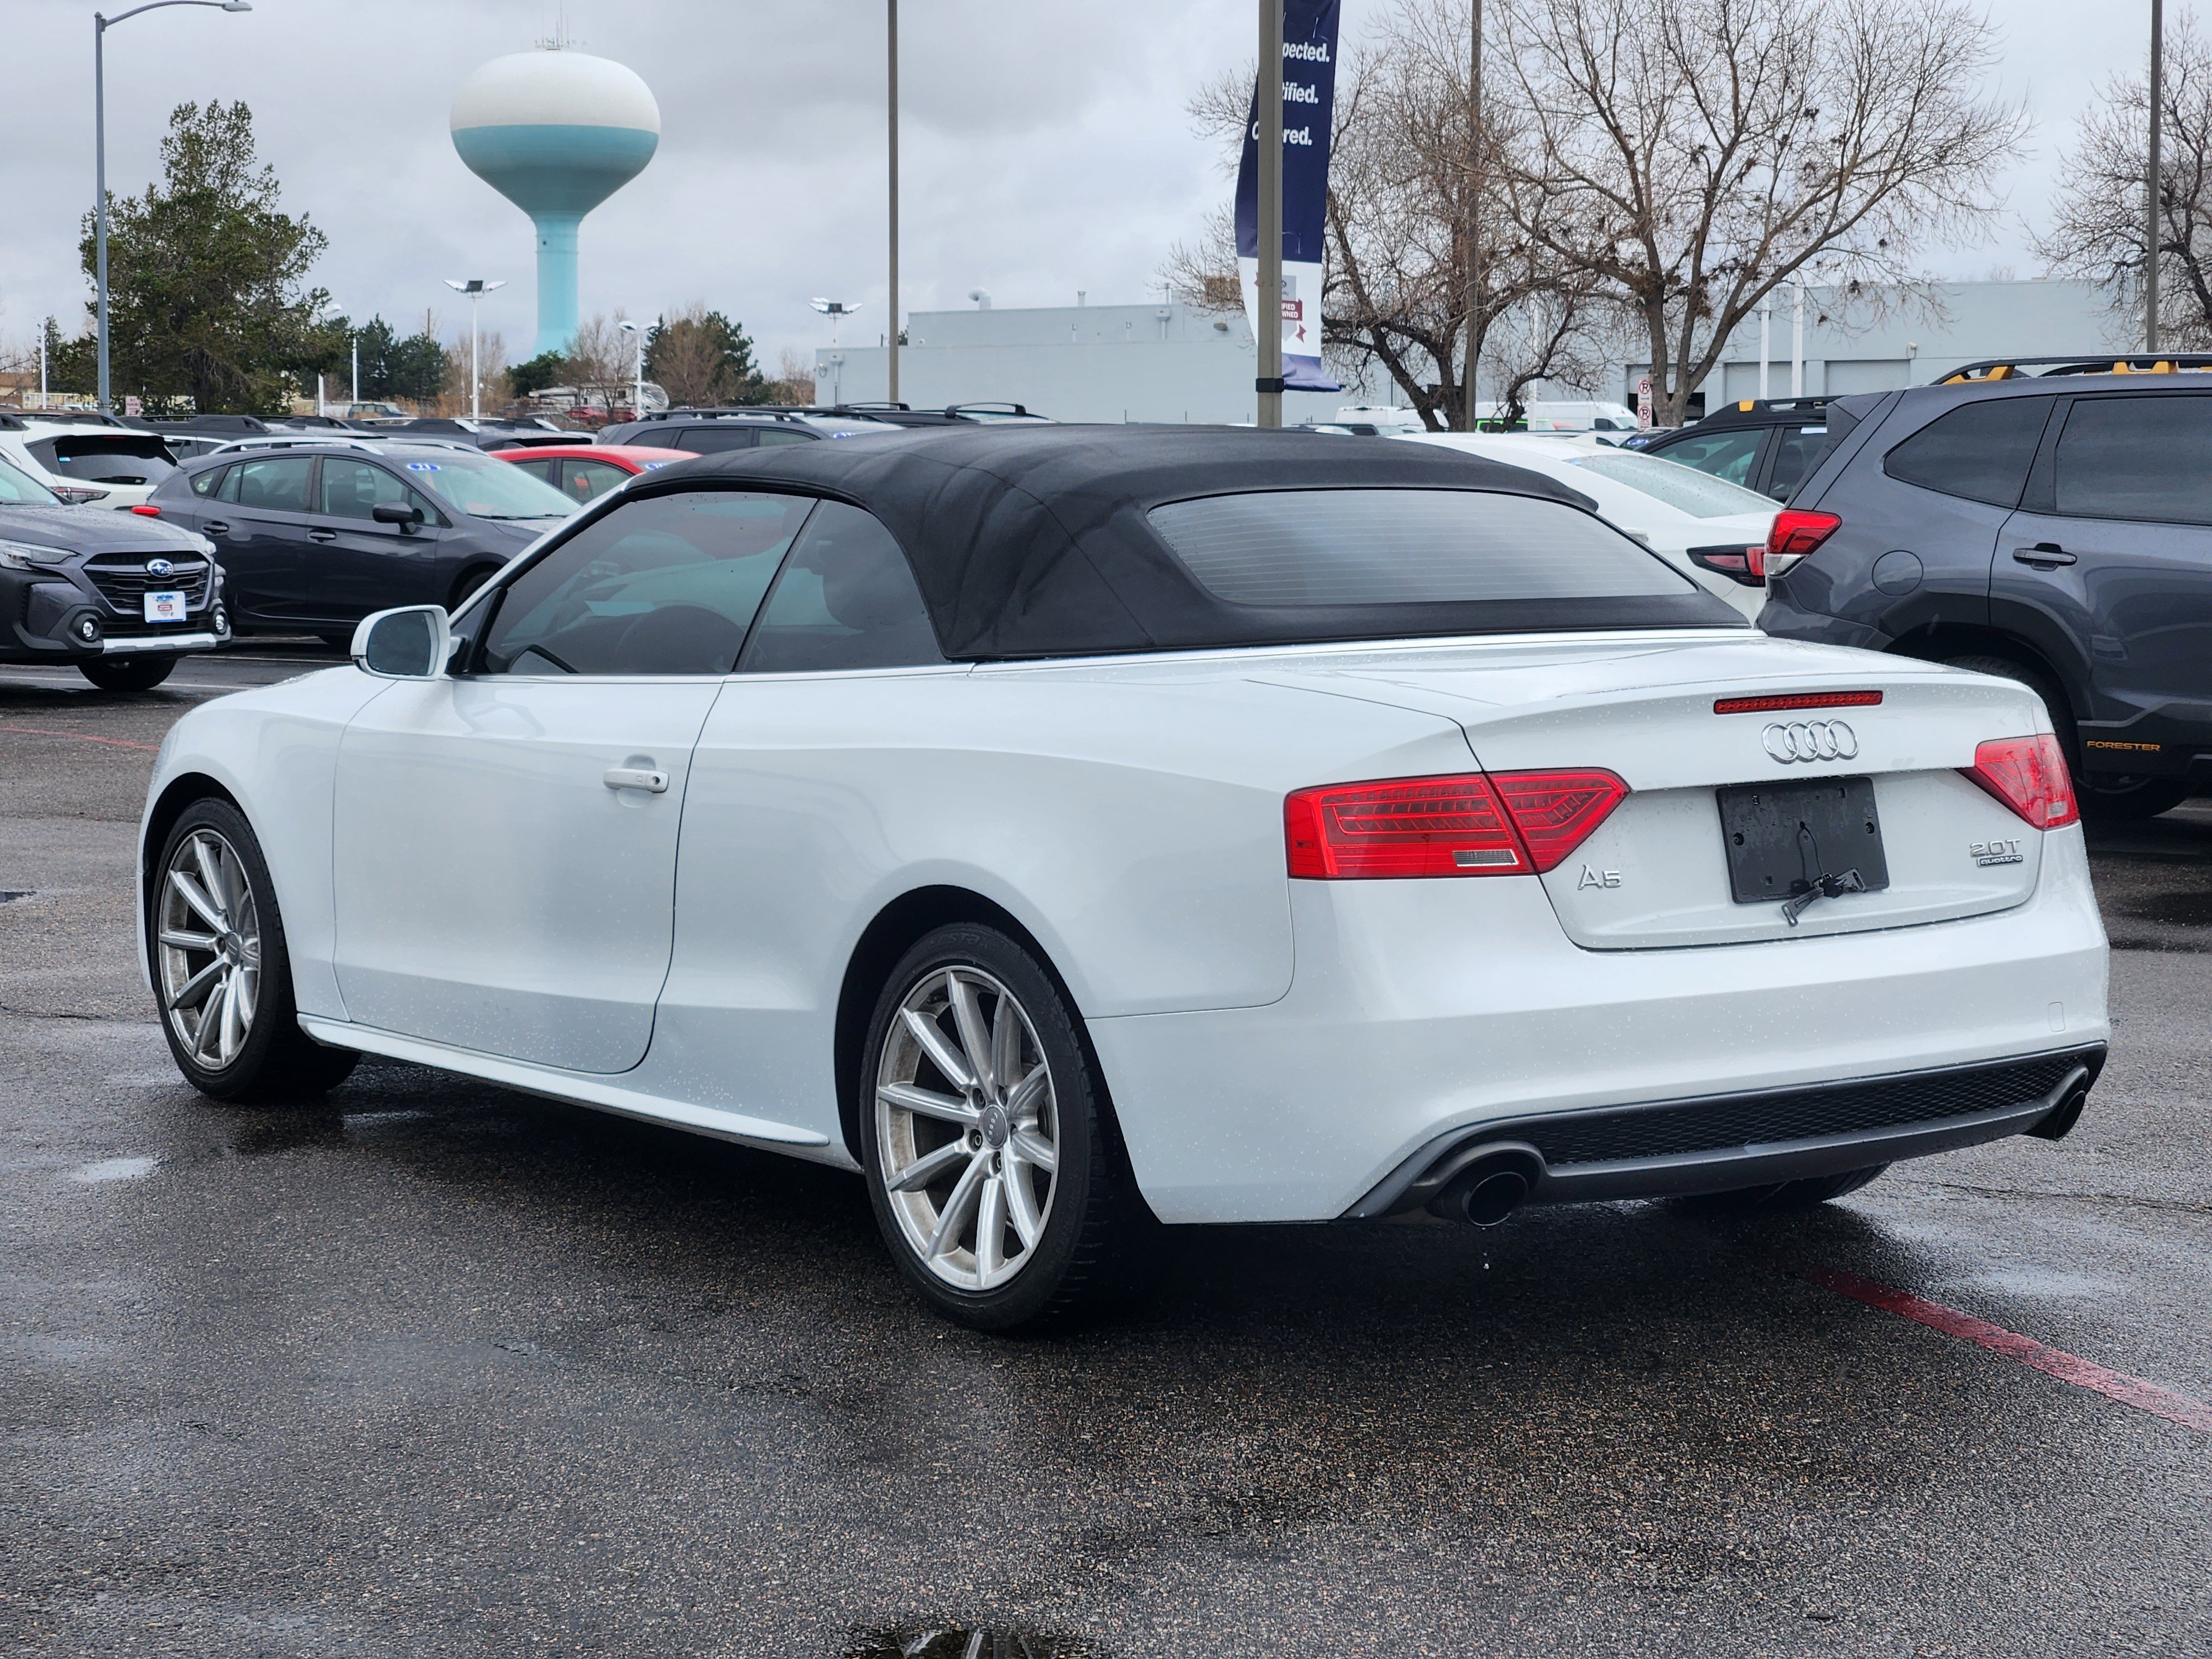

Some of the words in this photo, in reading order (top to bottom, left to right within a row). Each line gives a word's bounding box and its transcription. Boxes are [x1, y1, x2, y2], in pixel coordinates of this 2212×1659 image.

[1282, 41, 1330, 62] pected.
[1251, 121, 1312, 146] Cred.
[2086, 740, 2161, 752] FORESTER
[1969, 838, 2021, 858] 2.0T
[1979, 855, 2022, 865] quattro
[1577, 864, 1622, 891] A5
